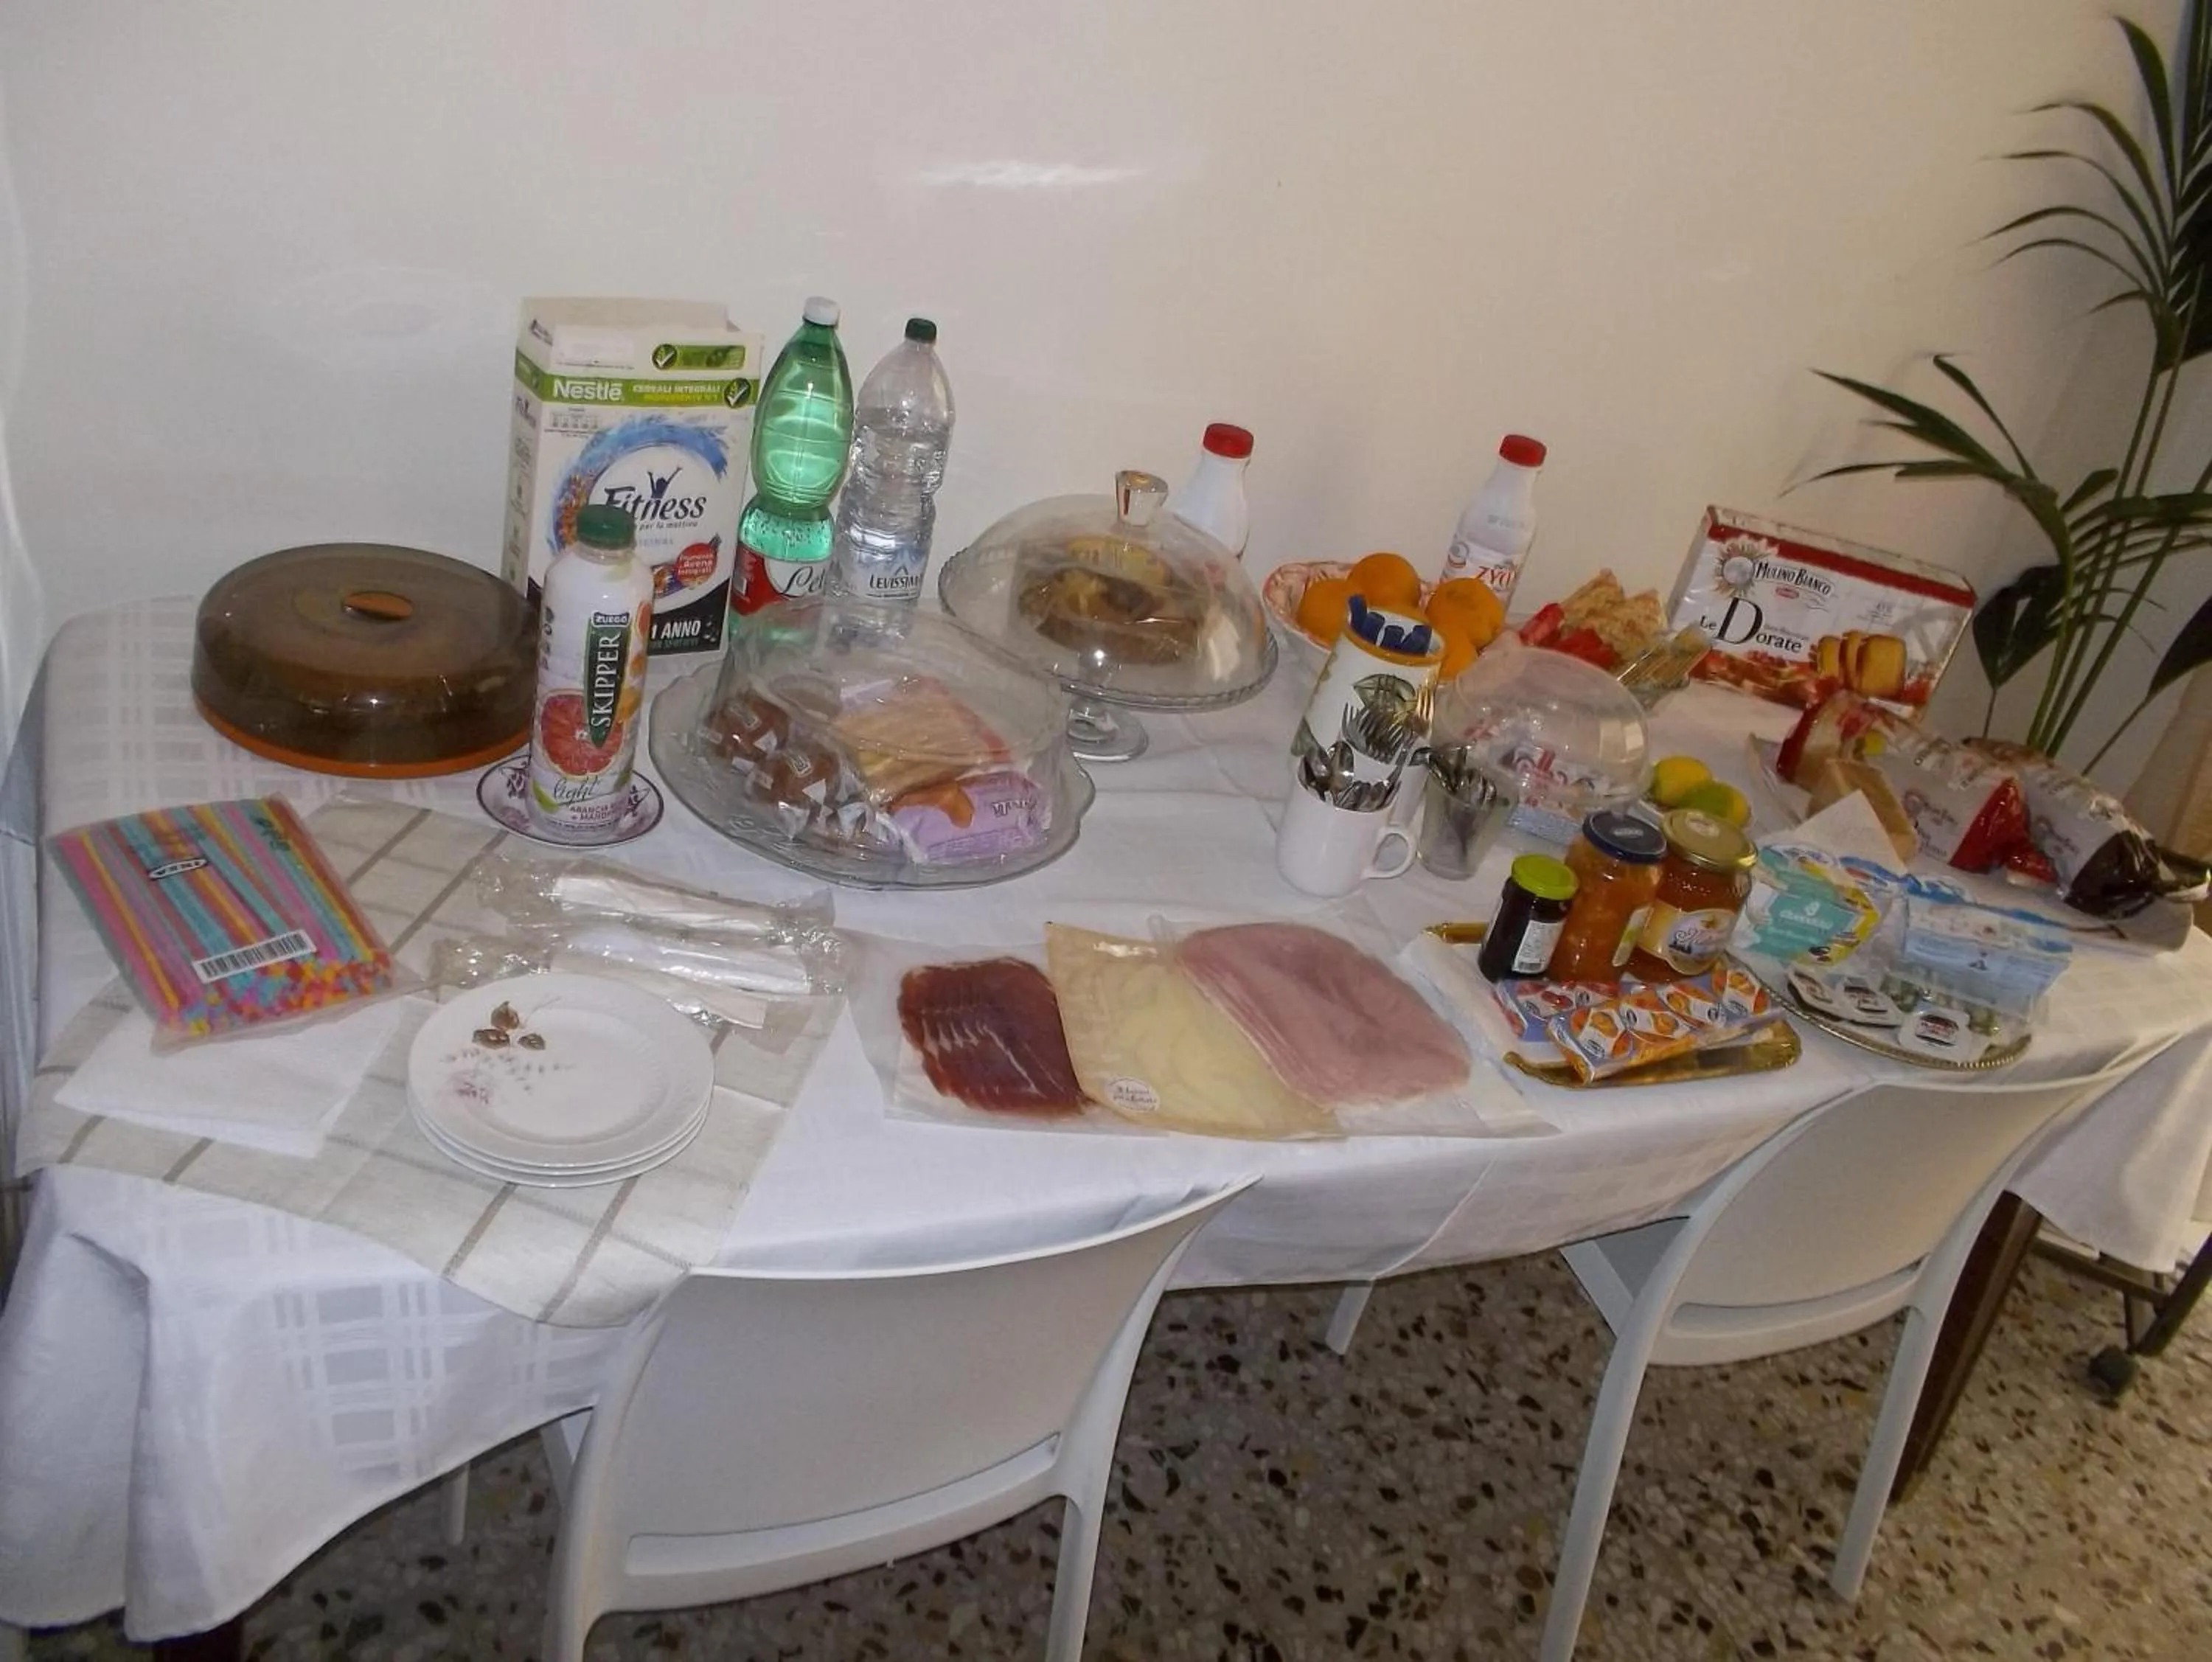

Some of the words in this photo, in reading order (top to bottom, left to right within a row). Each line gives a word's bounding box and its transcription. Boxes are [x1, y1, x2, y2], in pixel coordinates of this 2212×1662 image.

[604, 486, 707, 521] Fitness
[661, 620, 701, 639] ANNO
[1700, 615, 1717, 630] Le
[1713, 597, 1802, 653] Dorate
[591, 630, 621, 728] SKIPPER
